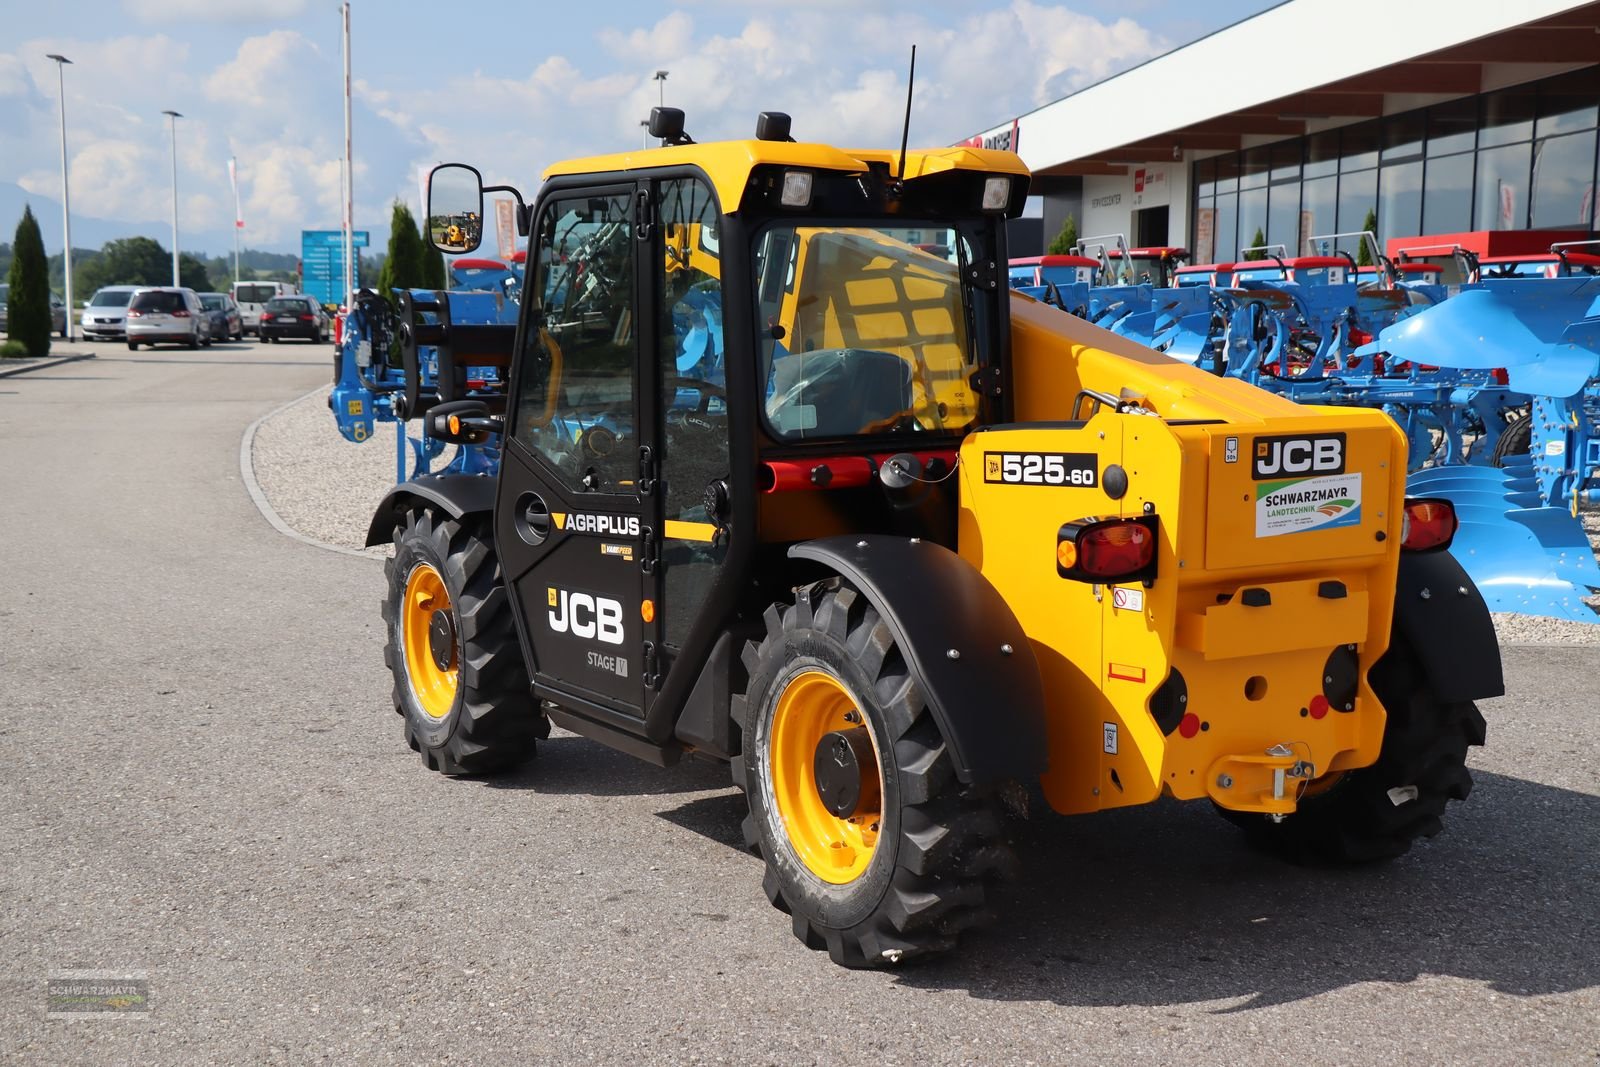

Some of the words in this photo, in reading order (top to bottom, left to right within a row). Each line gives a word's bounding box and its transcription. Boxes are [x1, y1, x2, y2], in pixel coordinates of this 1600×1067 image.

[1257, 438, 1342, 475] JCB
[1265, 487, 1348, 507] SCHWARZMAYR
[1267, 505, 1316, 518] LANDTECHNIK
[548, 589, 624, 645] JCB
[587, 651, 615, 672] STAGE
